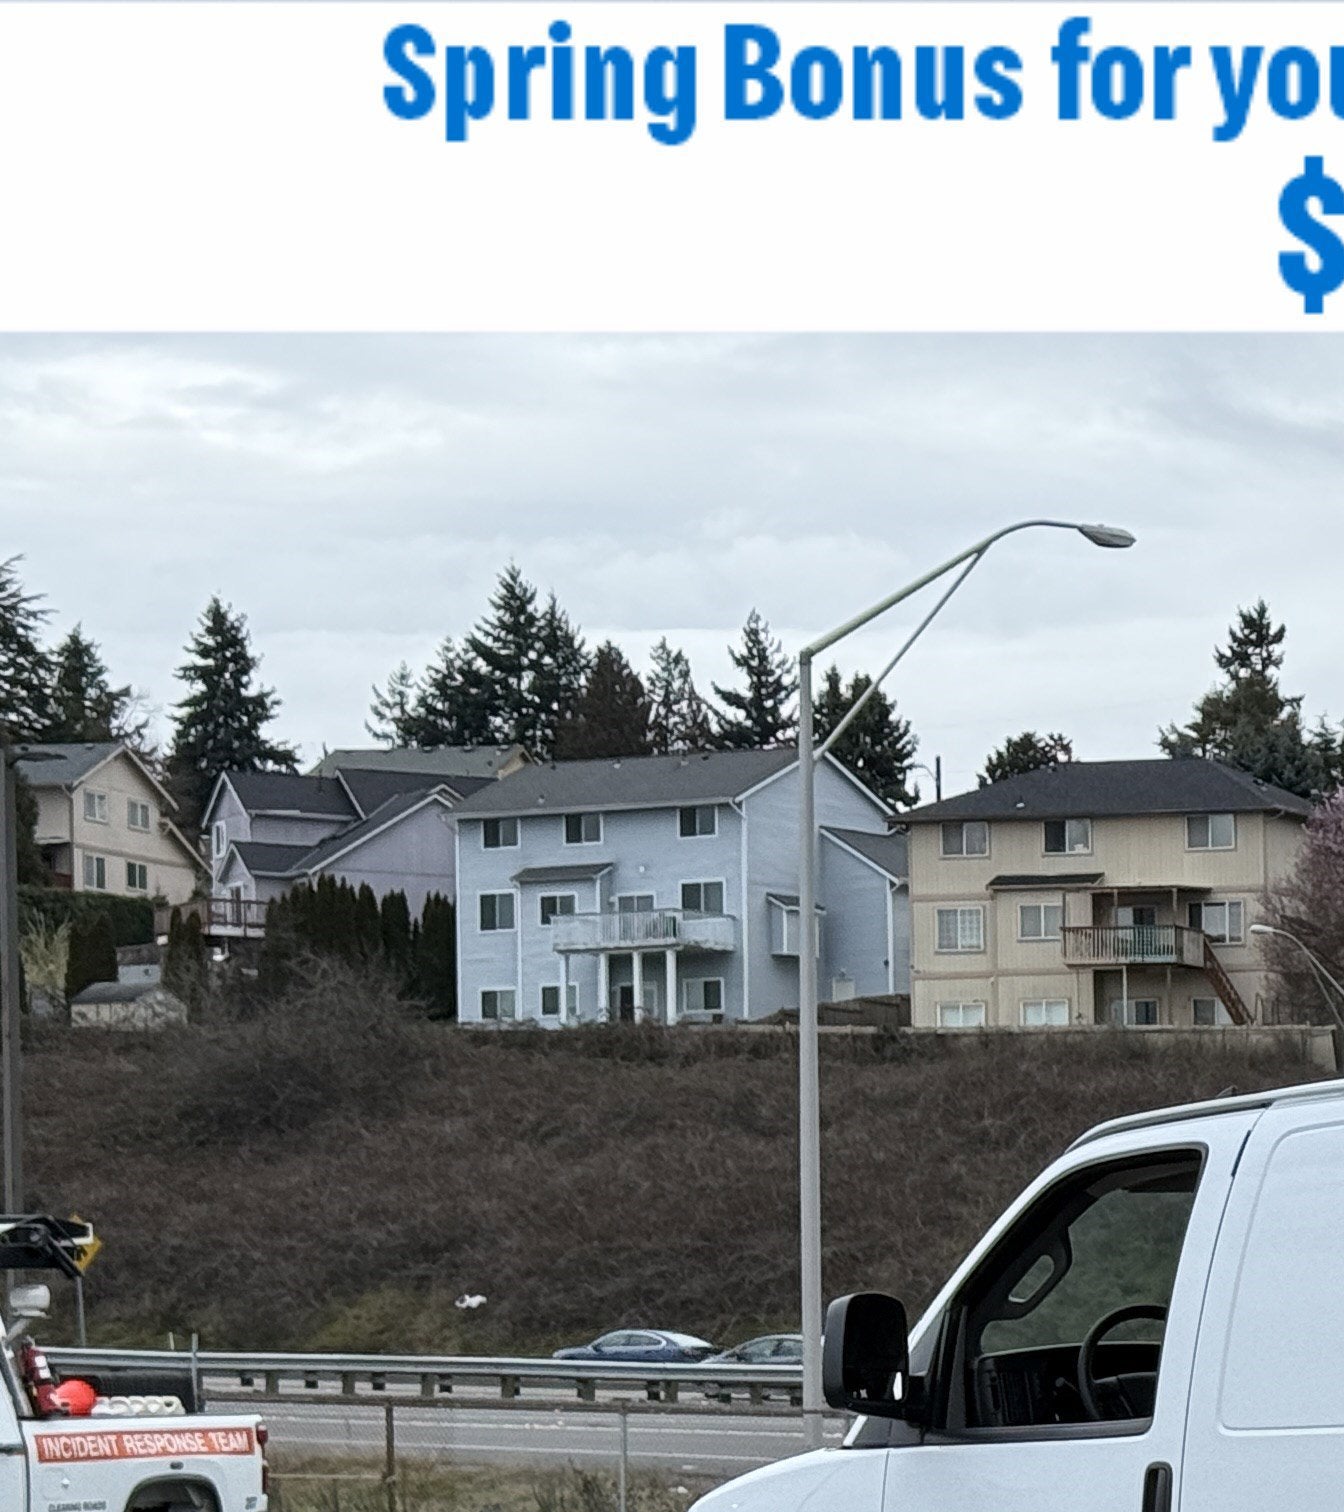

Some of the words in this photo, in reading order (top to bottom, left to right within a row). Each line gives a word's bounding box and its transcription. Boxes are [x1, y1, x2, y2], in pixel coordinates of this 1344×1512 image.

[42, 1434, 119, 1460] INCIDENT
[123, 1431, 207, 1457] RESPONSE
[208, 1430, 249, 1453] TEAM
